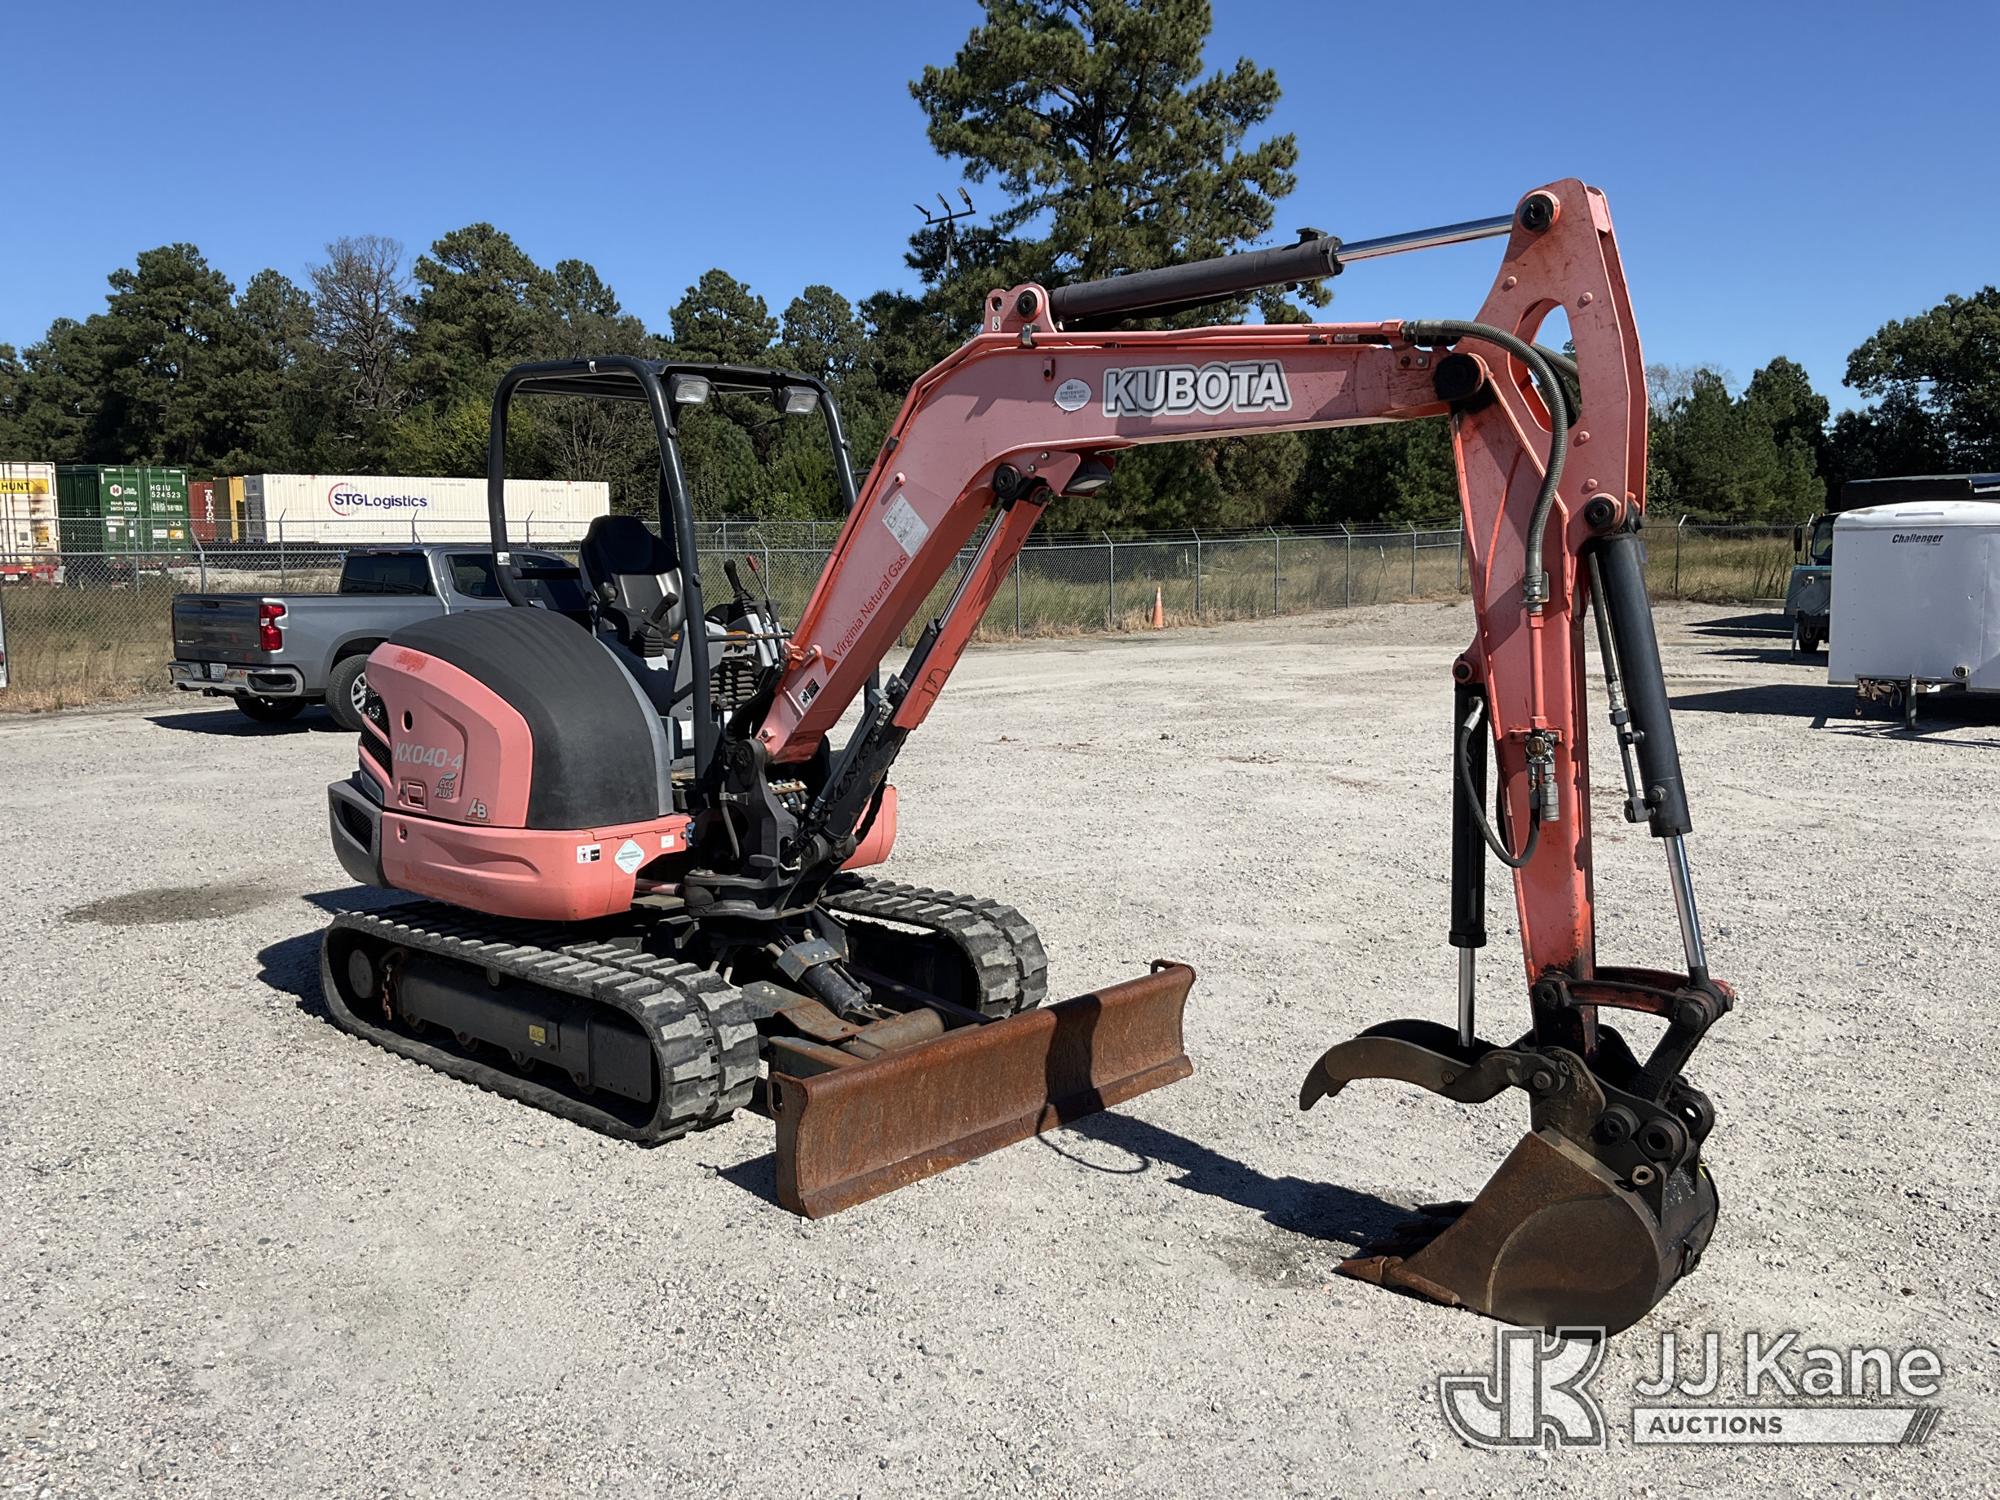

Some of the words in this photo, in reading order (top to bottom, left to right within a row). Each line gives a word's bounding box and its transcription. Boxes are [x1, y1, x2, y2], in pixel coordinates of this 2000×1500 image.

[1105, 363, 1288, 413] KUBOTA
[1, 482, 30, 491] HUNT
[1892, 534, 1944, 546] Challenger
[833, 617, 864, 657] Virginia
[860, 574, 891, 618] Natural
[888, 554, 907, 578] Gas
[395, 742, 464, 770] KX040-4
[439, 779, 455, 789] eco
[434, 787, 454, 798] PLUS
